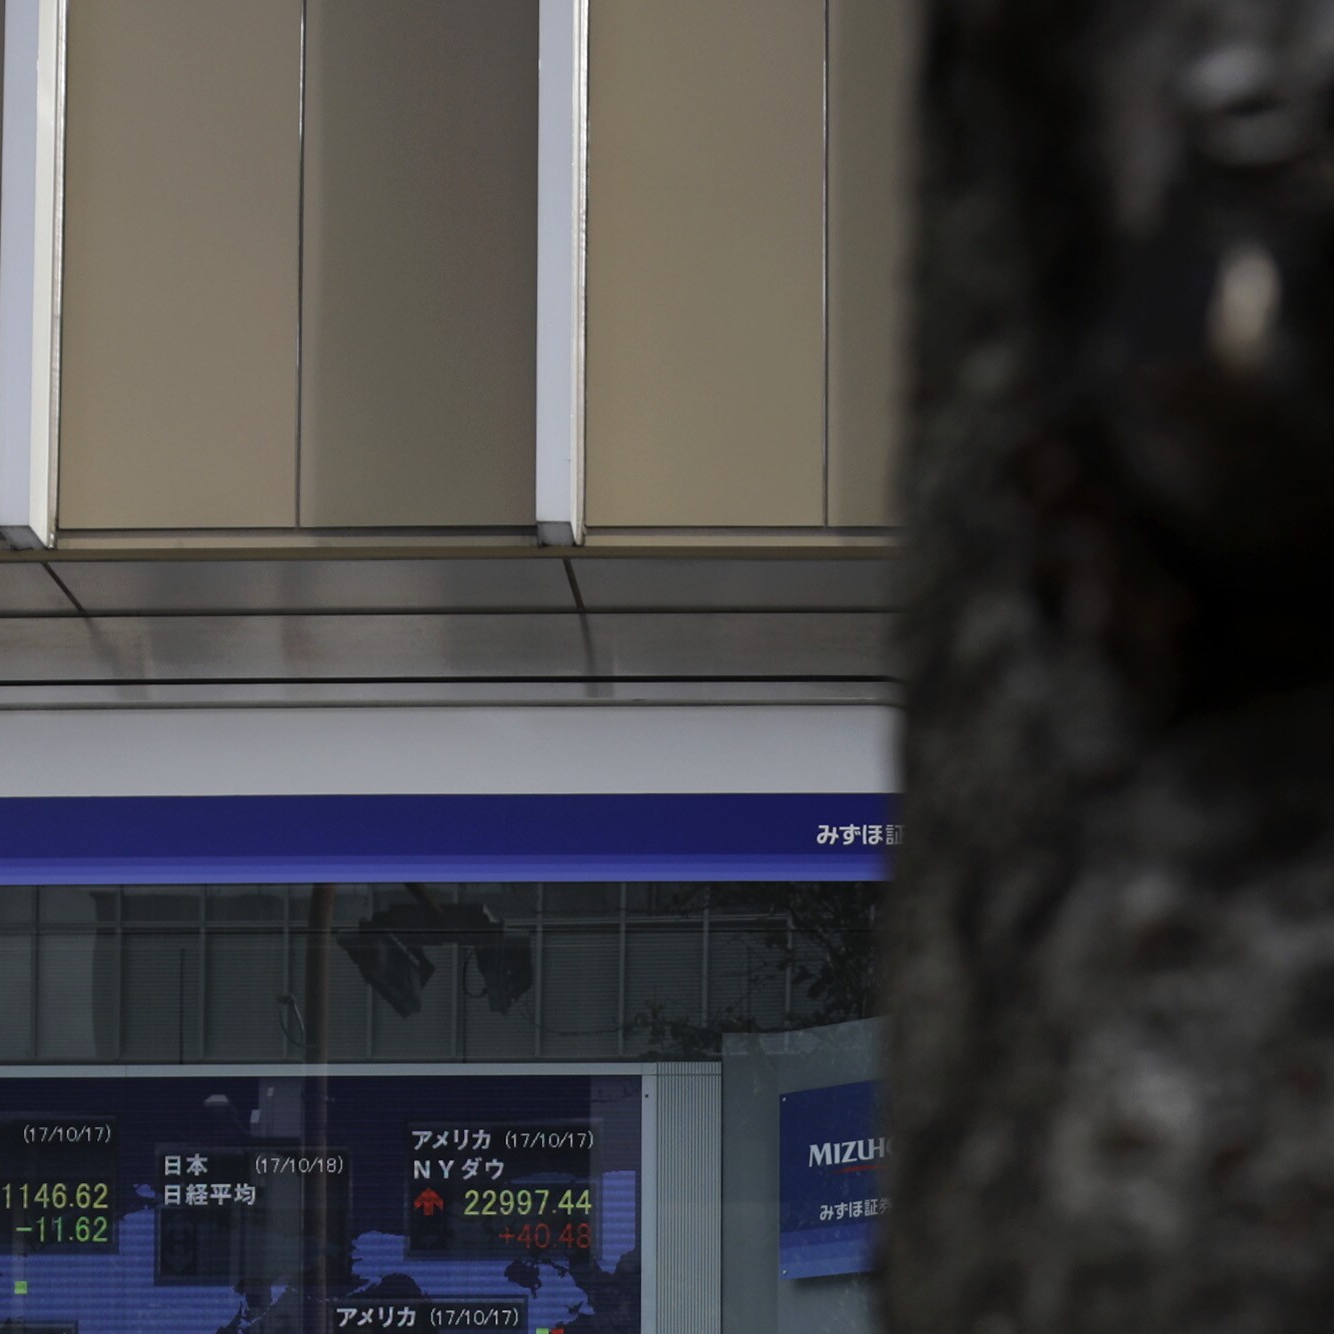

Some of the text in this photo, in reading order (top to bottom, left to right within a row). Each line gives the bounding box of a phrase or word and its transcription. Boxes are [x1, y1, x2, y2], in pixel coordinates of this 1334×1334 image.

[23, 1125, 111, 1143] (17/10/17)
[412, 1129, 594, 1150] アメリカ (17/10/17)
[164, 1154, 344, 1176] 日本 (17/10/18)
[2, 1183, 109, 1209] 1146.62
[164, 1184, 256, 1206] 日経平均
[464, 1189, 593, 1215] 22997.44
[16, 1216, 109, 1242] -11.62
[498, 1223, 593, 1249] +40.48
[336, 1307, 519, 1328] アメリカ (17/10/17)
